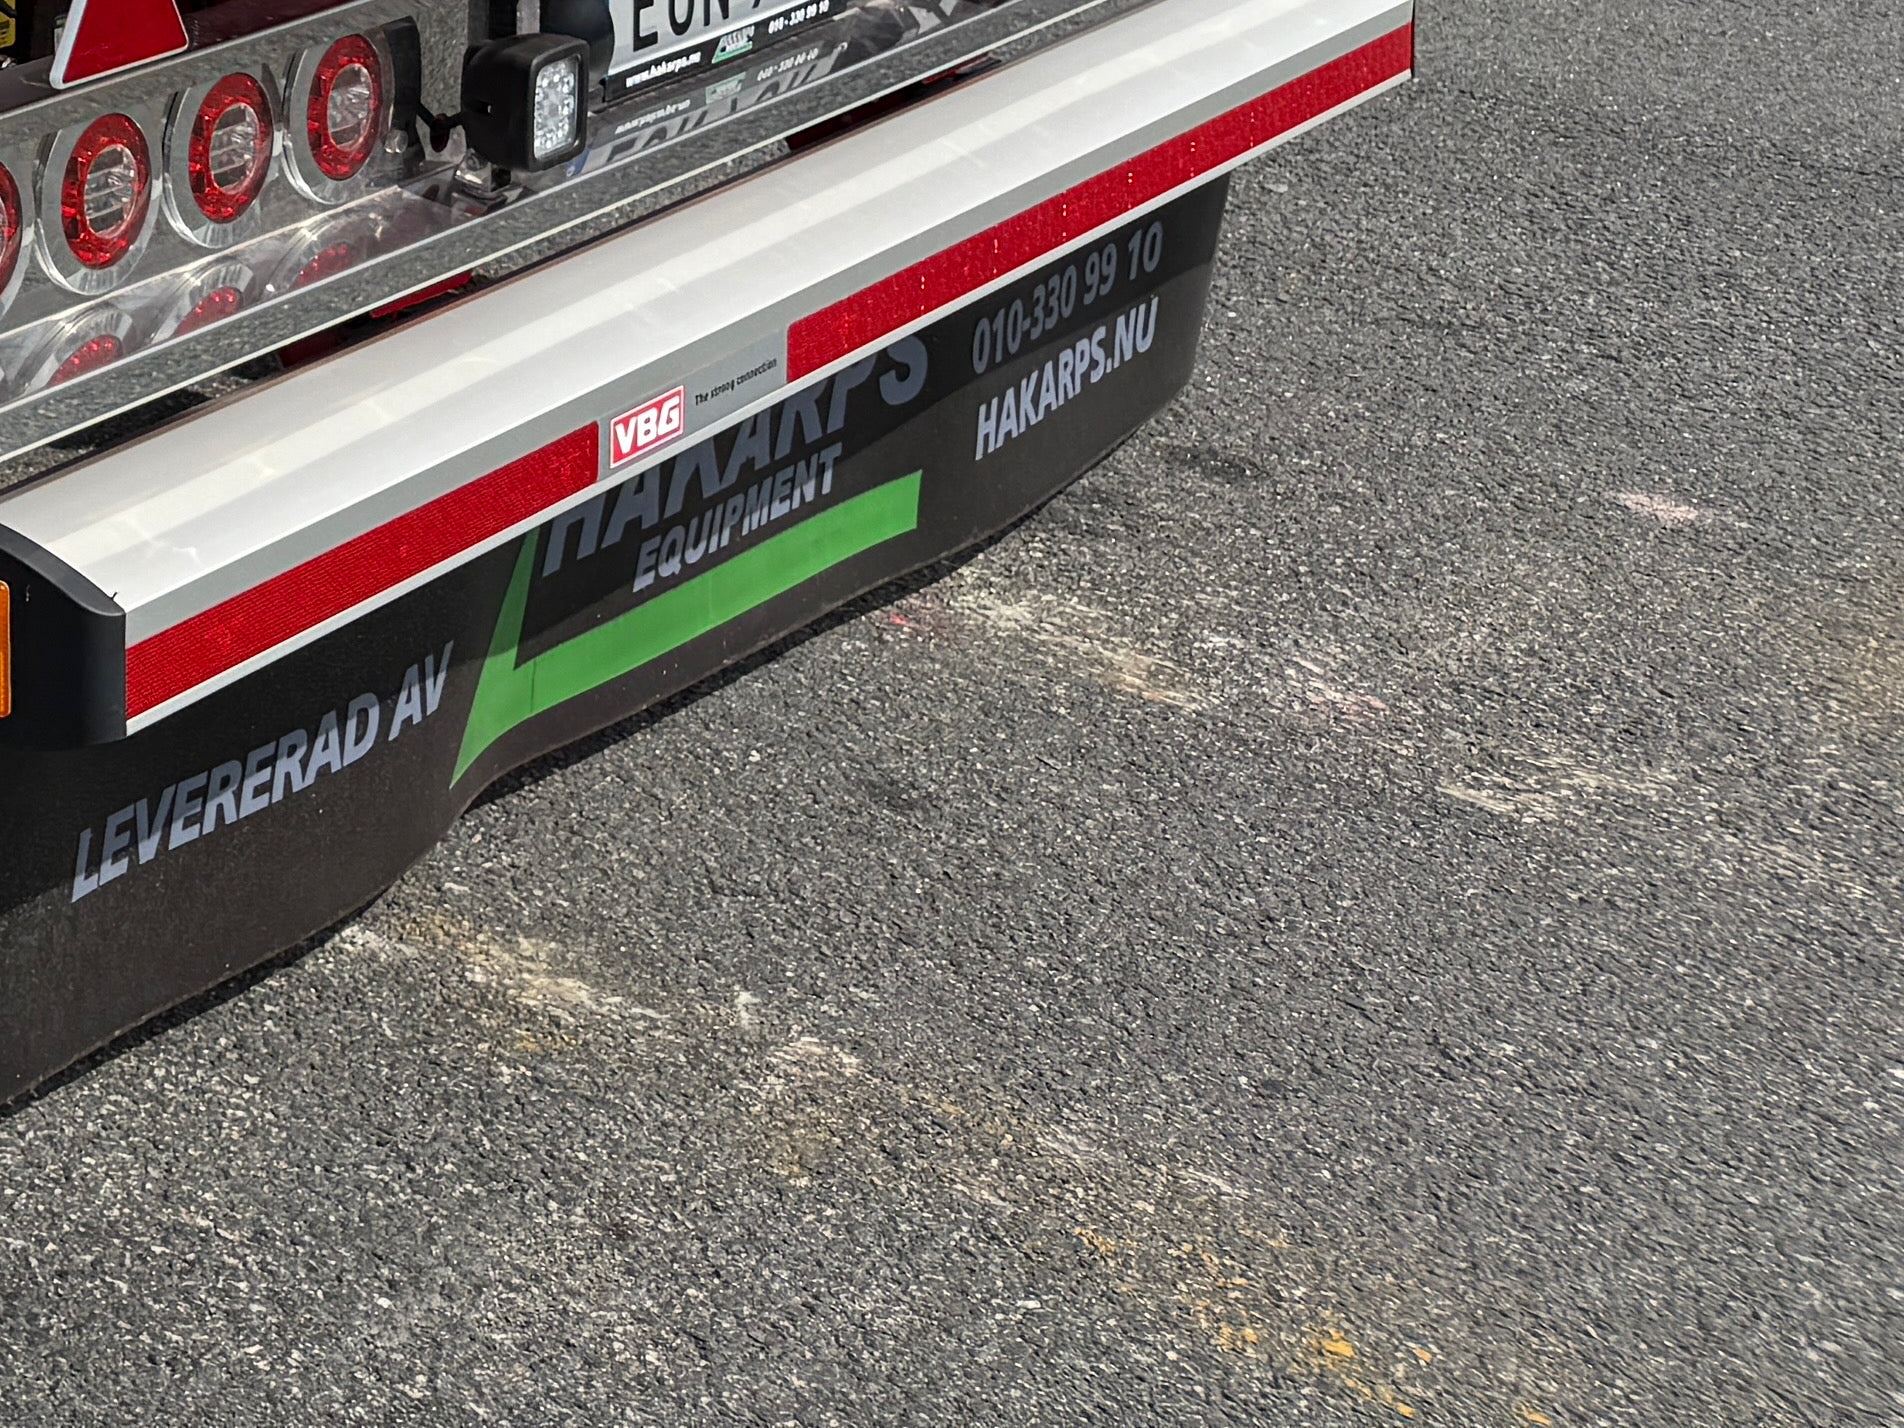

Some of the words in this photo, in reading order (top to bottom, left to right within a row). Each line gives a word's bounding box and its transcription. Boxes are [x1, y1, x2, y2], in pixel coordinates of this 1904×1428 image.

[972, 264, 1078, 375] 010-330
[1083, 242, 1118, 306] 99
[1128, 220, 1164, 281] 10
[615, 395, 681, 455] VBG
[975, 296, 1160, 462] HAKARPS.NU
[632, 442, 843, 594] EQUIPMENT
[71, 691, 381, 904] LEVERERAD
[388, 639, 454, 742] AV
